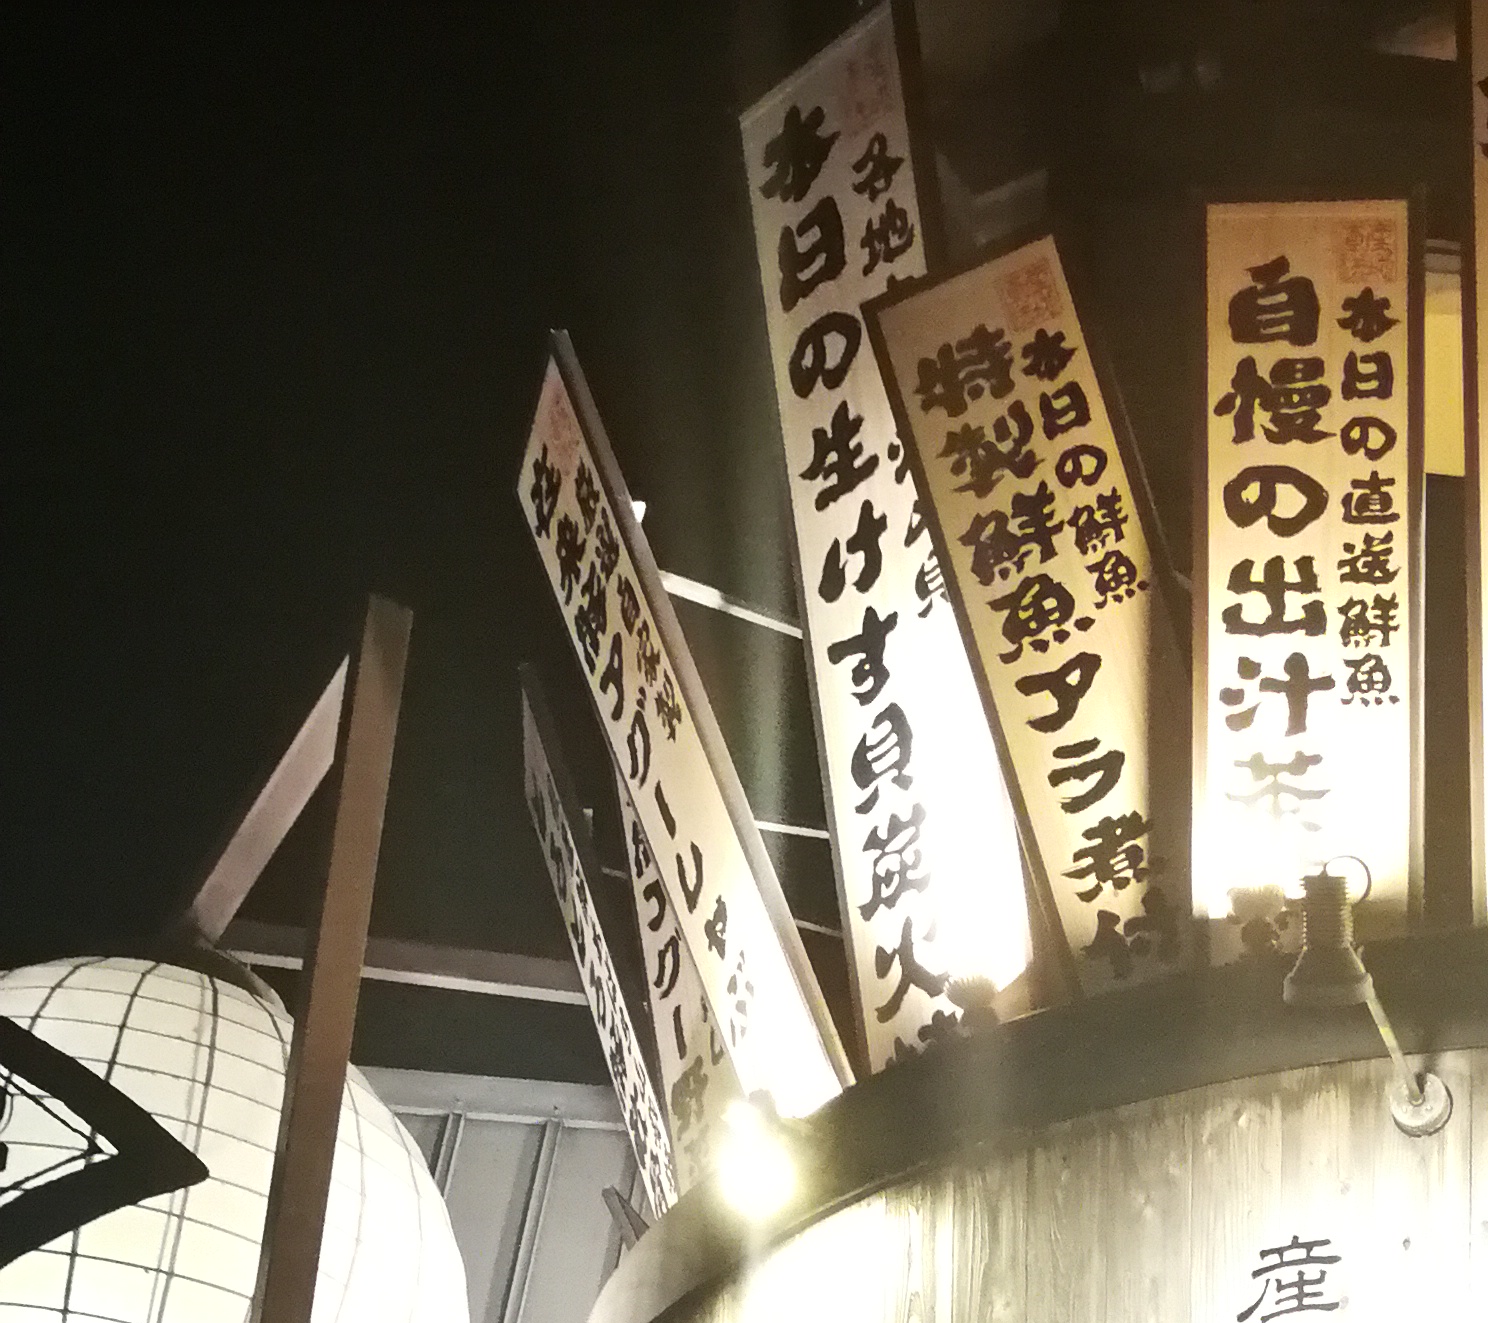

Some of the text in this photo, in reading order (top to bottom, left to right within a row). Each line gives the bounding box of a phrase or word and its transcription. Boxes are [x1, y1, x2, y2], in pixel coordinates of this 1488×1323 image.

[1021, 327, 1149, 608] 本日の鮮魚
[1335, 287, 1401, 706] 本日の直送鮮魚
